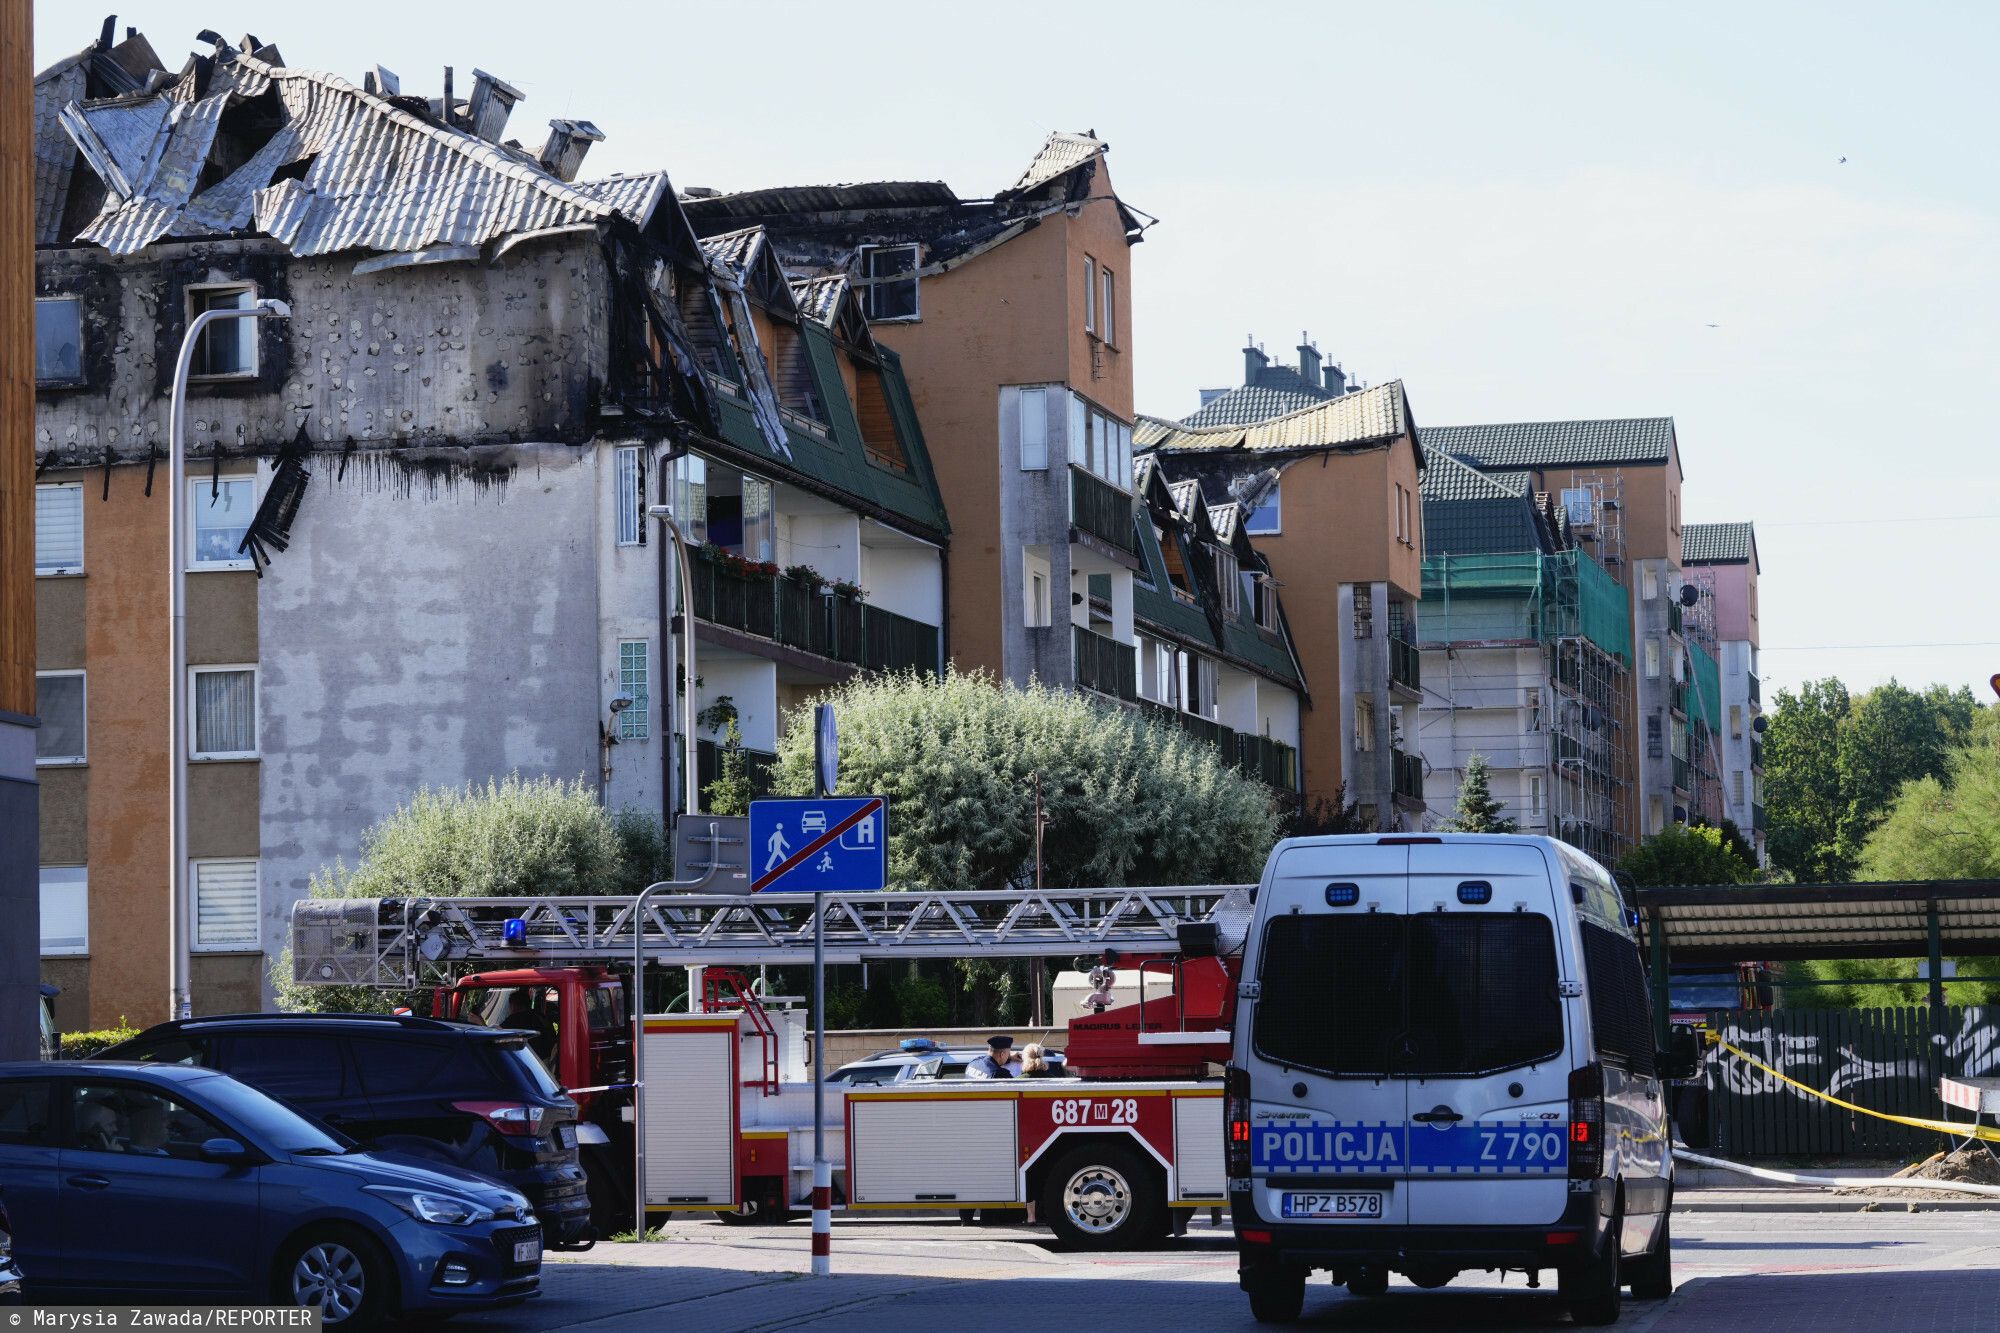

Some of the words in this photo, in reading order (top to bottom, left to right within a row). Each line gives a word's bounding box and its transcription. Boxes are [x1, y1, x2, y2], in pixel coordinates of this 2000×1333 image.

[1051, 1099, 1092, 1124] 687
[1111, 1099, 1138, 1124] 28
[1263, 1132, 1398, 1161] POLICJA
[1480, 1133, 1497, 1160] Z
[1504, 1132, 1561, 1161] 790
[1294, 1196, 1330, 1212] HPZ
[1336, 1196, 1378, 1212] B578
